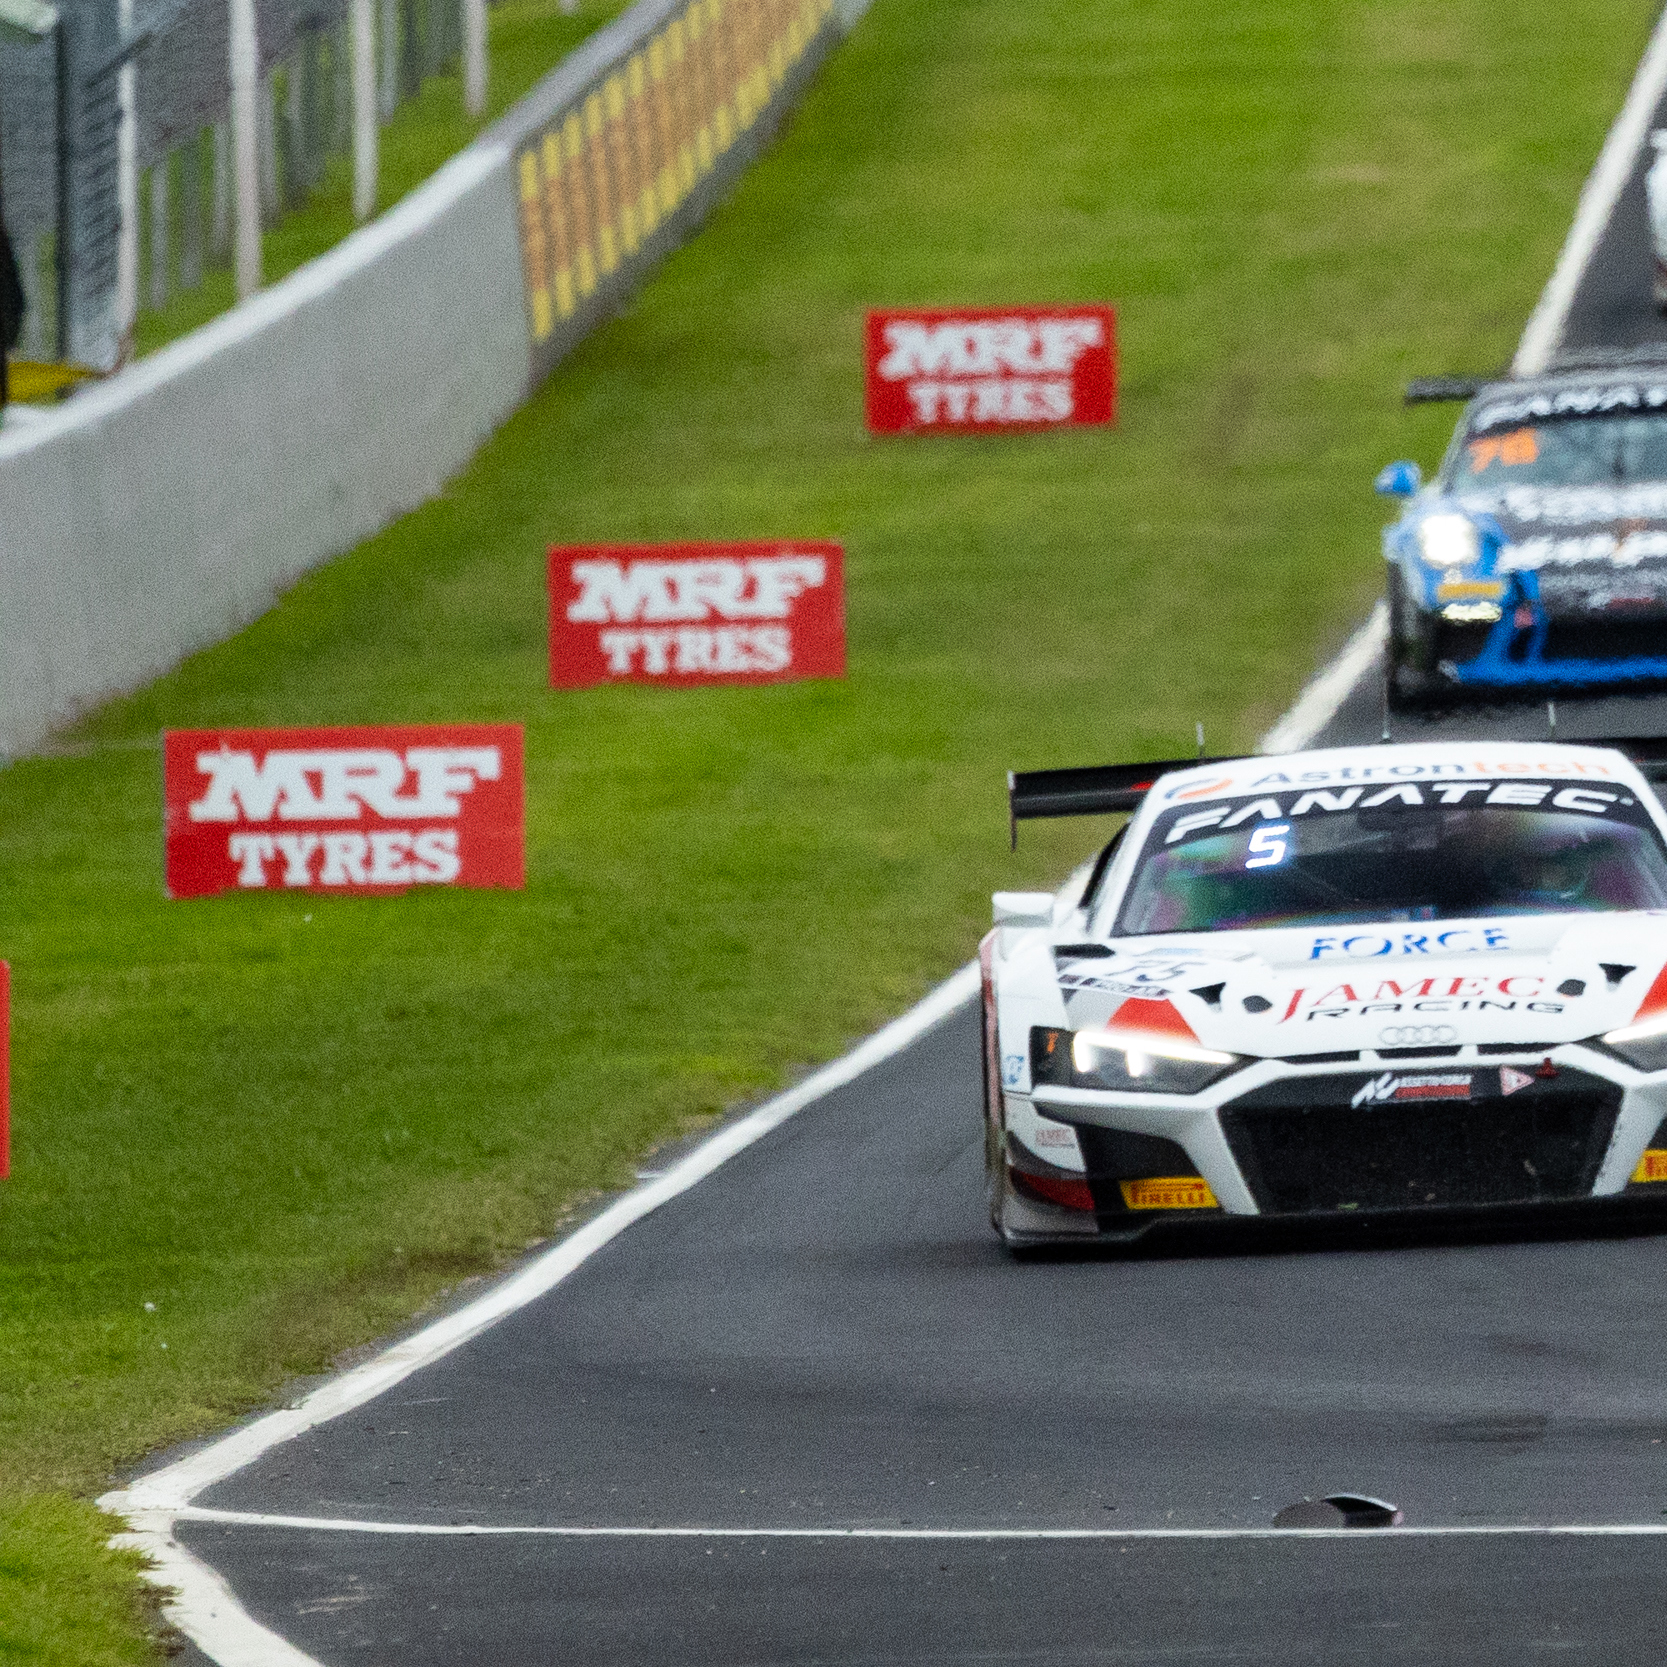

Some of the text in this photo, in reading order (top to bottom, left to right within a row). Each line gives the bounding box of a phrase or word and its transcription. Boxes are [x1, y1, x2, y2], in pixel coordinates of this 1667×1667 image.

[879, 318, 1102, 379] MRF
[908, 378, 1076, 423] TYRES
[568, 556, 825, 624] MRF
[600, 623, 791, 676] TYRES
[189, 745, 500, 822] MRF
[1250, 761, 1609, 788] Astrontech
[1165, 783, 1619, 844] FANATEC
[228, 829, 462, 890] TYRES
[1246, 825, 1290, 869] 5
[1309, 927, 1510, 960] FORCE
[1277, 977, 1544, 1024] JAMEC
[1306, 1001, 1565, 1022] RACING
